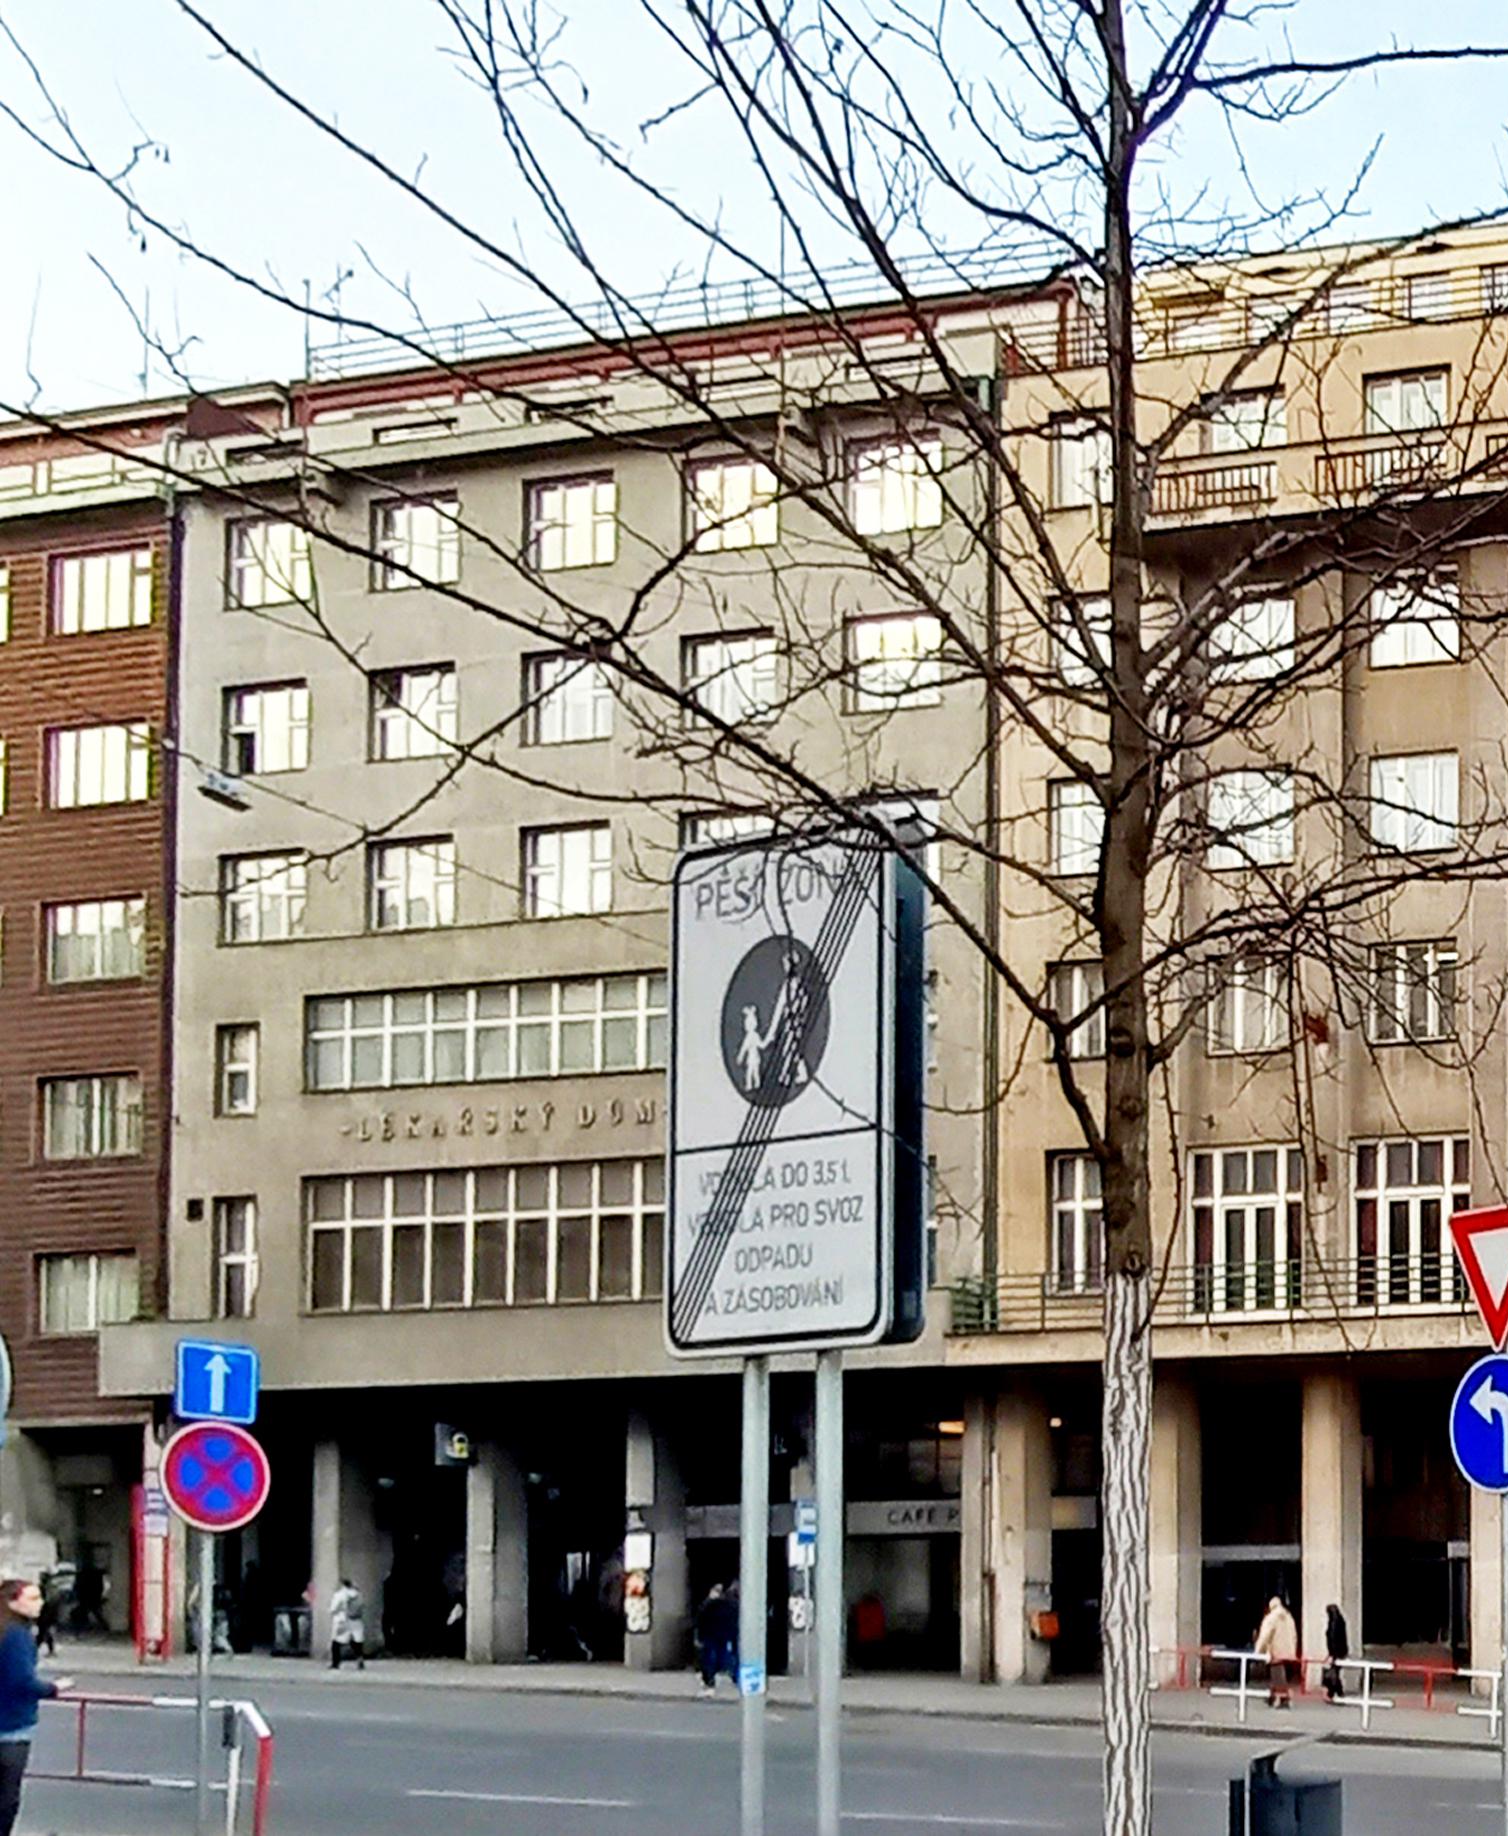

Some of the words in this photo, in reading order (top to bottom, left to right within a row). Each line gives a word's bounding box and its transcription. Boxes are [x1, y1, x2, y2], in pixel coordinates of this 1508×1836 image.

[781, 1161, 808, 1188] DO
[770, 1201, 809, 1230] PRO
[814, 1195, 864, 1226] SVOZ
[734, 1242, 813, 1274] ODPADU
[704, 1290, 718, 1316] A
